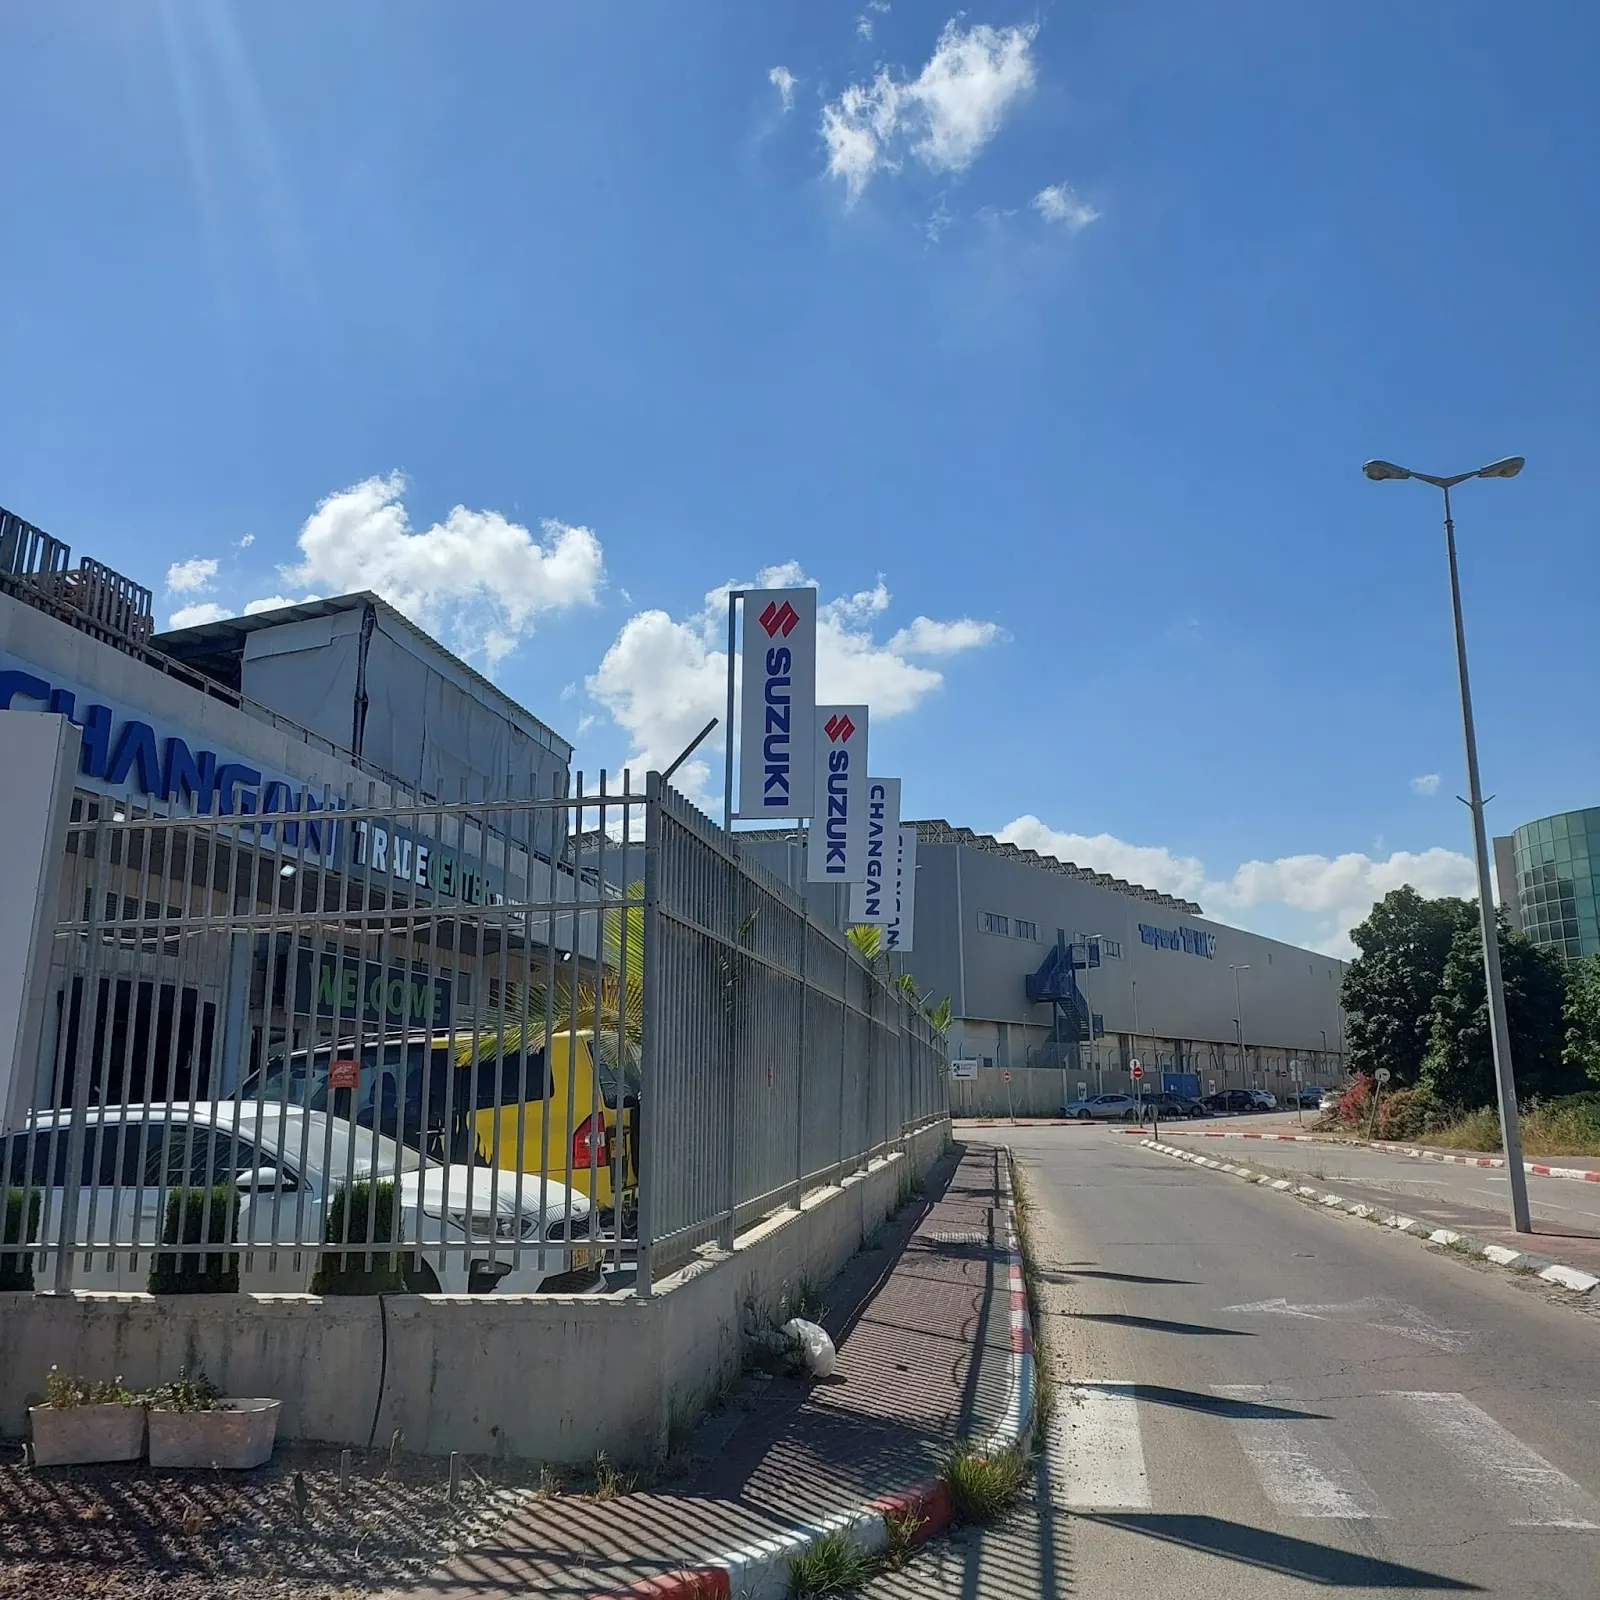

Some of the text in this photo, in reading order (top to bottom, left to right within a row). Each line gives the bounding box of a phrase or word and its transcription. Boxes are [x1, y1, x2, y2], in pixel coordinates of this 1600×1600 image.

[763, 646, 792, 807] SUZUKI
[826, 749, 849, 874] SUZUKI
[865, 784, 885, 916] CHANGAN
[309, 962, 443, 1020] WECOME
